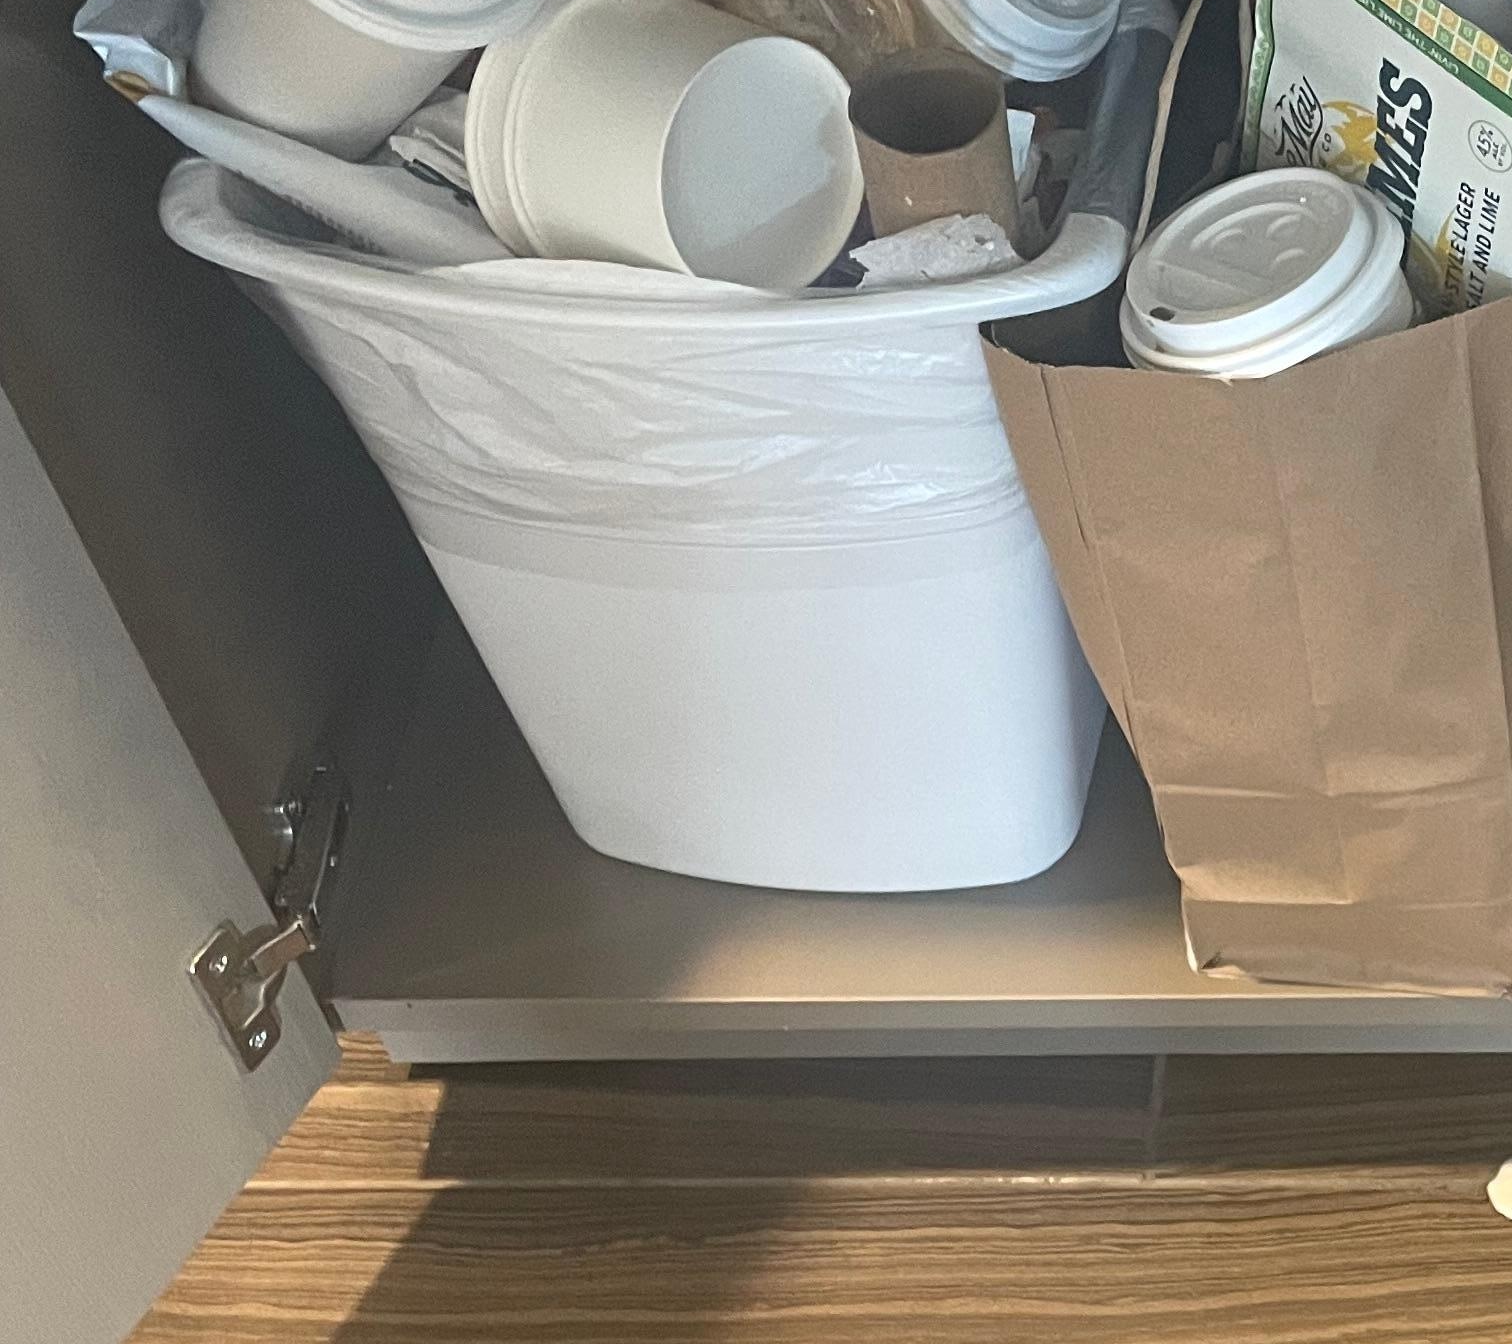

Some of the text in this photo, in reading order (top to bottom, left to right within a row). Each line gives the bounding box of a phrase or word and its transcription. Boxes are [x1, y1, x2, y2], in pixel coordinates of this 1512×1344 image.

[1364, 57, 1433, 270] MES
[1452, 182, 1476, 241] LAGER
[1479, 187, 1501, 234] LIME
[1472, 234, 1492, 275] AND
